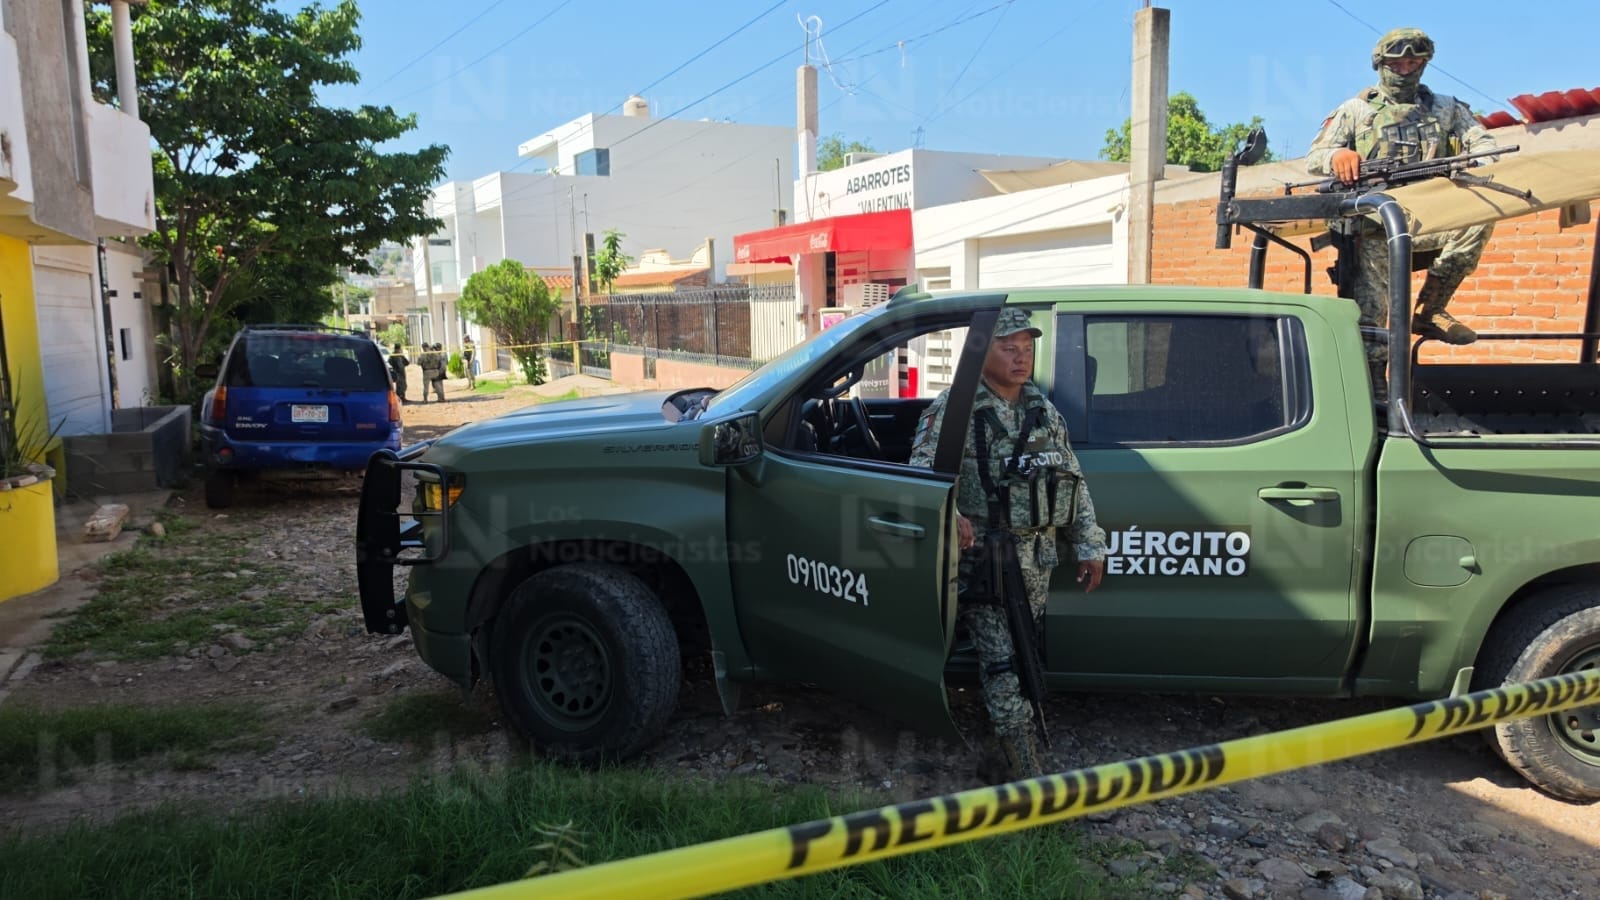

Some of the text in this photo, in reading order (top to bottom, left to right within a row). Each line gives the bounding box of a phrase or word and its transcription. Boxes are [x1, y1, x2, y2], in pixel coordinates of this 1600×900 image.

[846, 164, 910, 195] ABARROTES
[1104, 525, 1250, 556] JÉRCITO
[787, 553, 869, 606] 0910324
[1107, 556, 1246, 576] EXICANO
